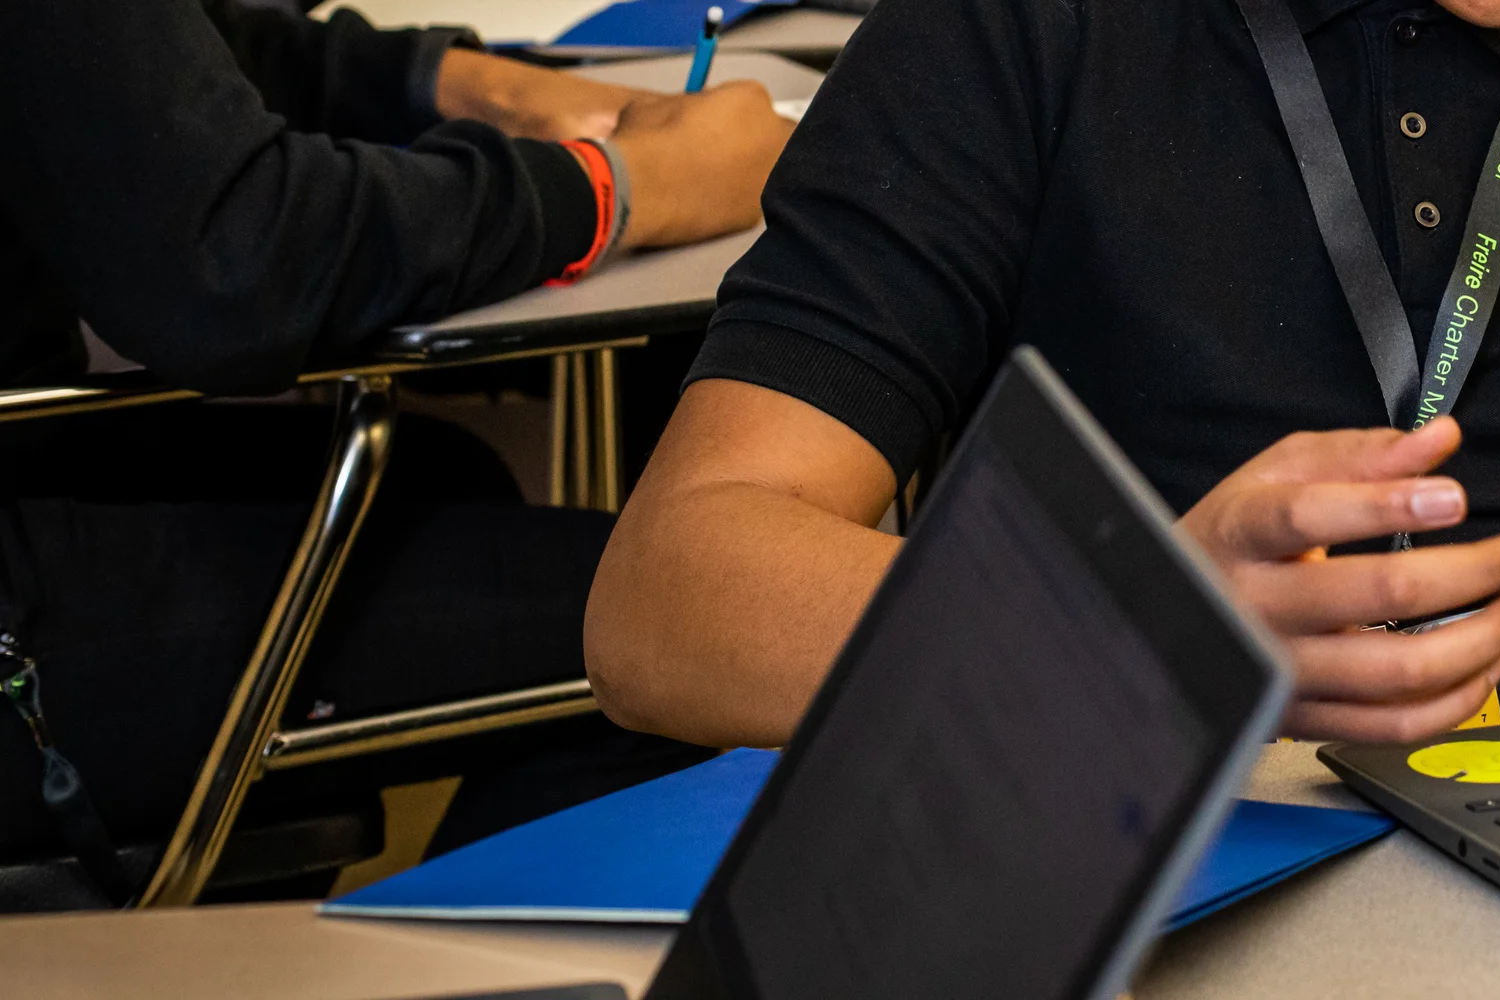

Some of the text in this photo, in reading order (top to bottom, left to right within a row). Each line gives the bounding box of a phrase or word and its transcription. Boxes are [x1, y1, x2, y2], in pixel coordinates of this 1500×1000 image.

[1412, 232, 1498, 432] Freire Charter Mi
